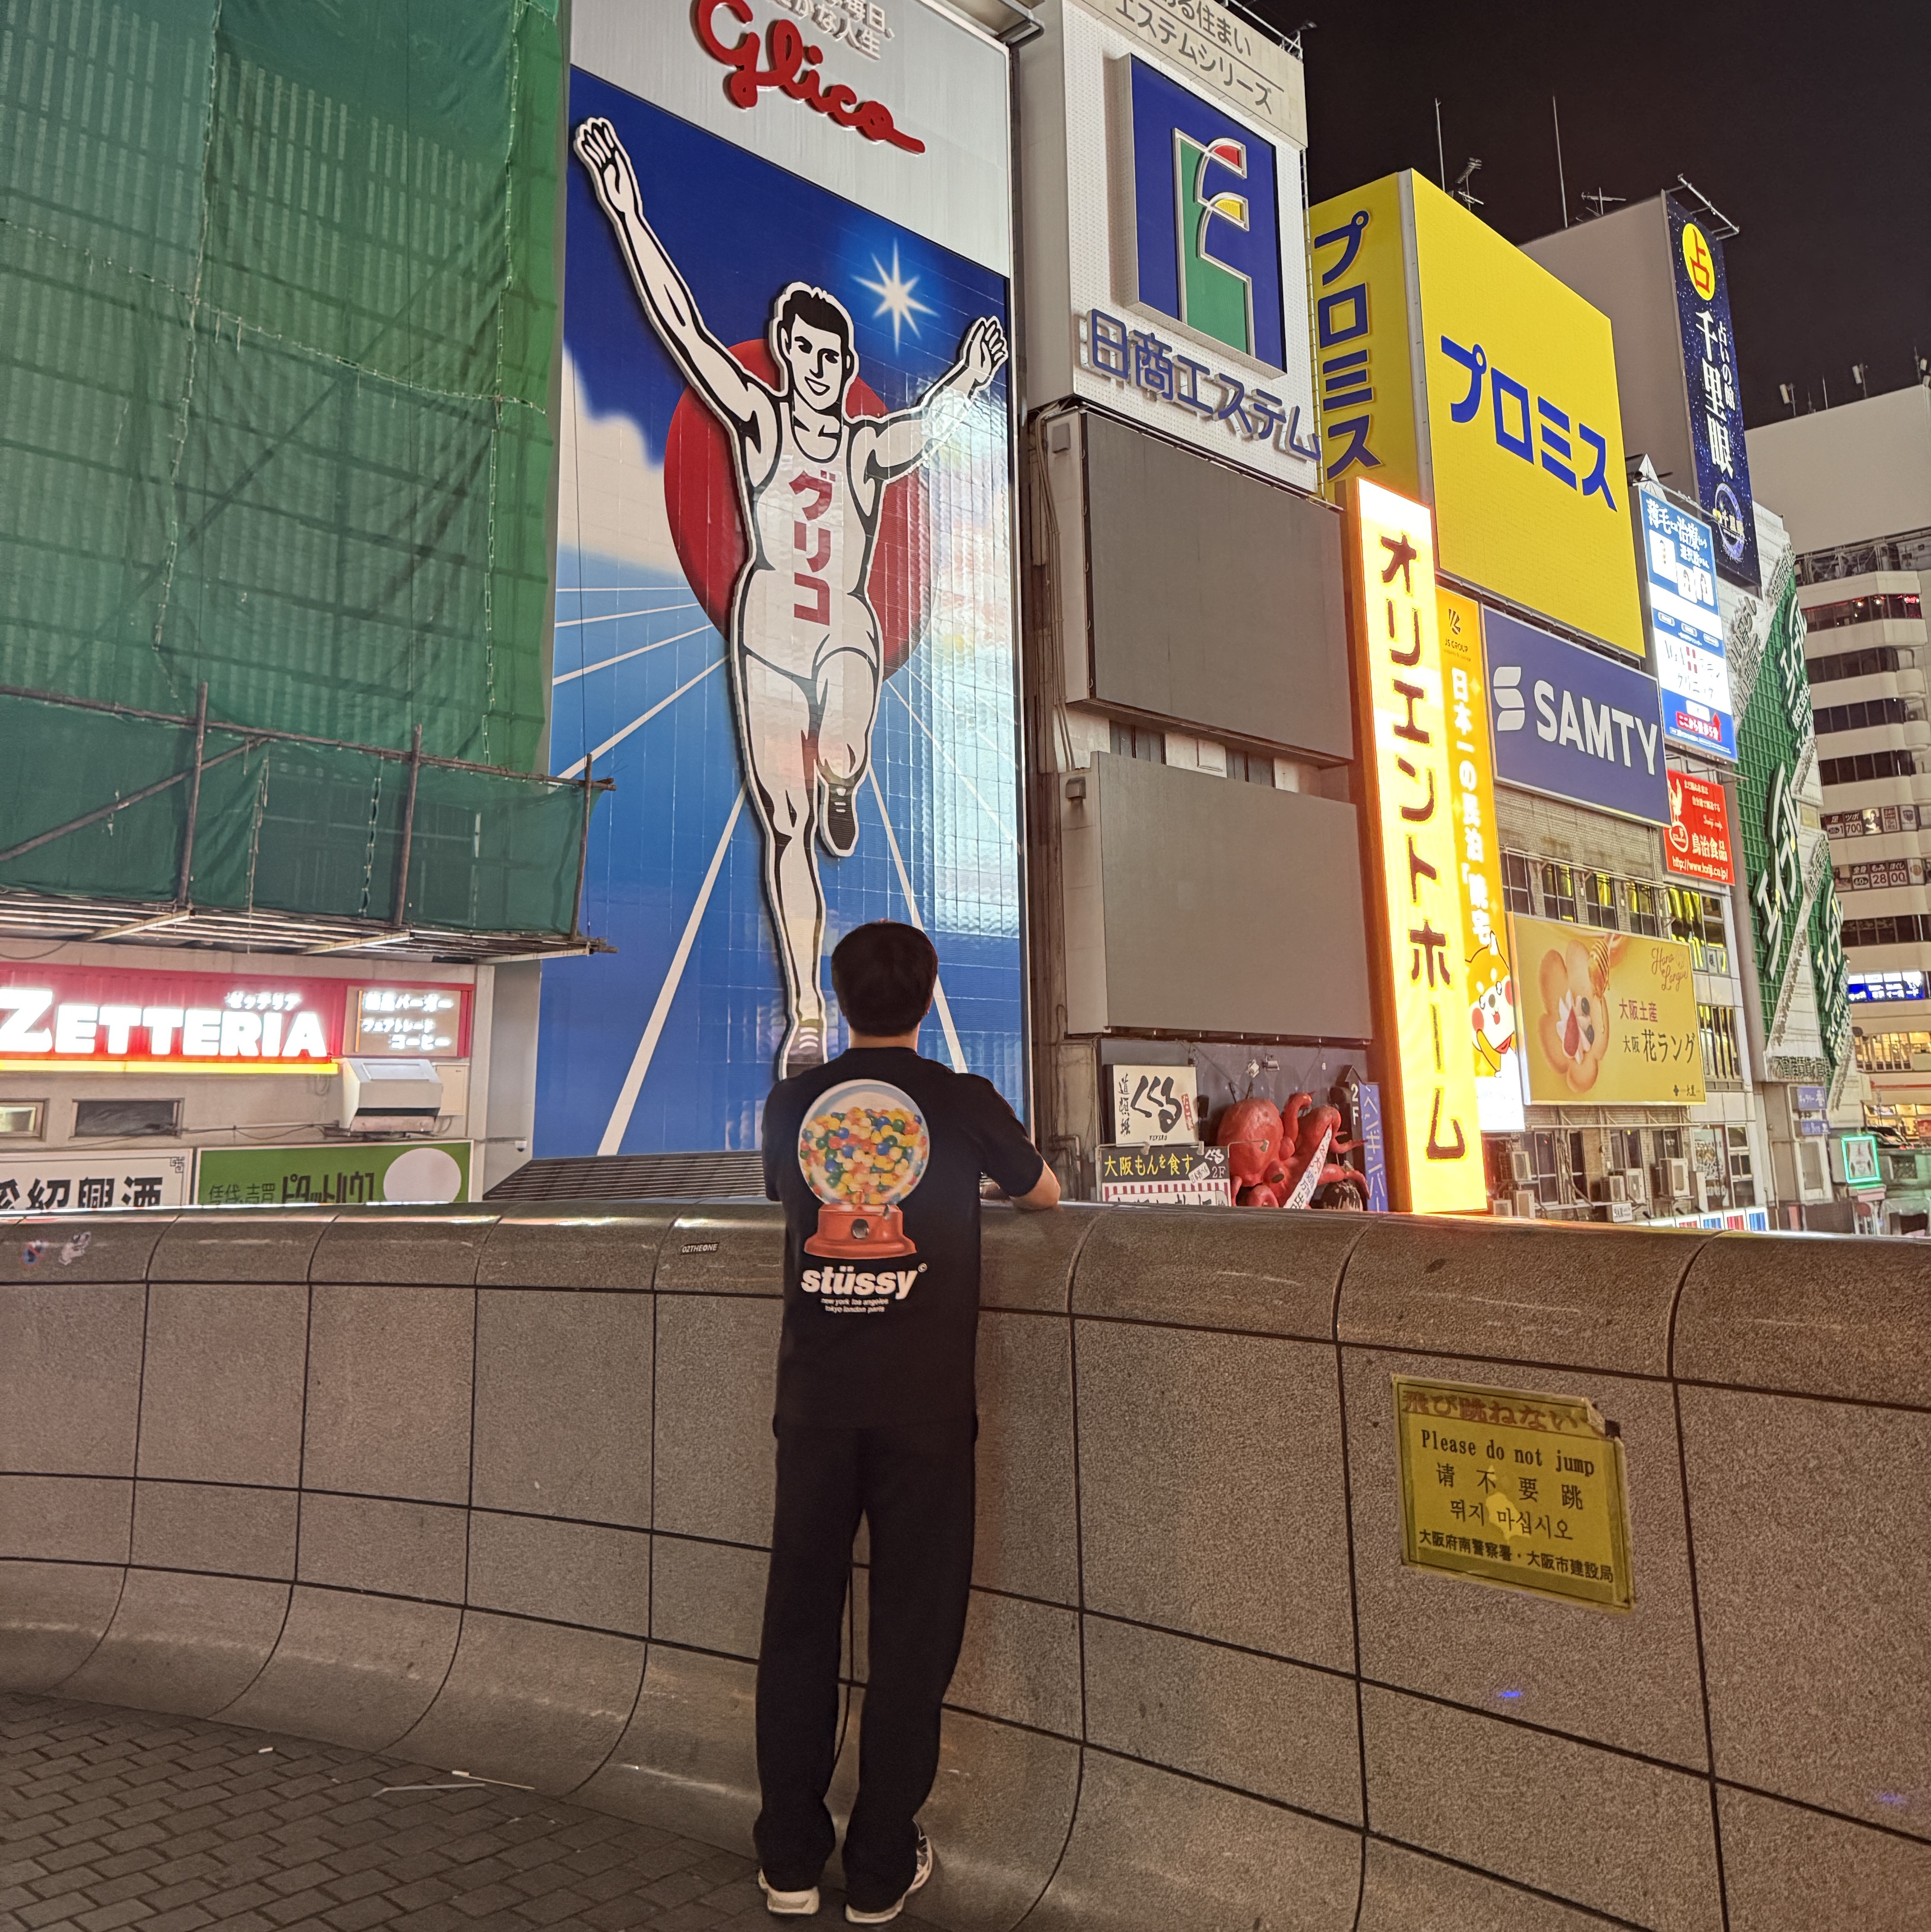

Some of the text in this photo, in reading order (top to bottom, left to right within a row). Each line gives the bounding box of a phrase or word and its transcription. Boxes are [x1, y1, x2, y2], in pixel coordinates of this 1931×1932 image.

[823, 0, 895, 41] 毎日、
[1167, 0, 1252, 56] る住まい
[697, 0, 926, 155] Glico
[1689, 227, 1711, 294] 占
[1314, 210, 1383, 482] プロミス
[1718, 321, 1736, 411] 占いの館
[1087, 308, 1321, 462] 日商エステム
[1695, 310, 1734, 480] 千里眼
[1440, 335, 1618, 513] プロミス
[789, 470, 836, 626] グリコ
[1534, 680, 1658, 776] SAMTY
[1380, 532, 1465, 1159] オリエントホーム
[0, 988, 328, 1058] ZETTERIA
[1619, 997, 1658, 1023] 大阪土産
[391, 1034, 451, 1051] コーヒー
[1130, 1075, 1183, 1133] くくる
[1105, 1152, 1193, 1177] 大阪もんを食す
[1212, 1166, 1226, 1178] 2F
[801, 1266, 918, 1300] stüssy
[1402, 1390, 1588, 1431] 飛び跳ねない
[1421, 1429, 1595, 1478] Please do not jump
[1450, 1499, 1574, 1541] 뛰지 마십시오
